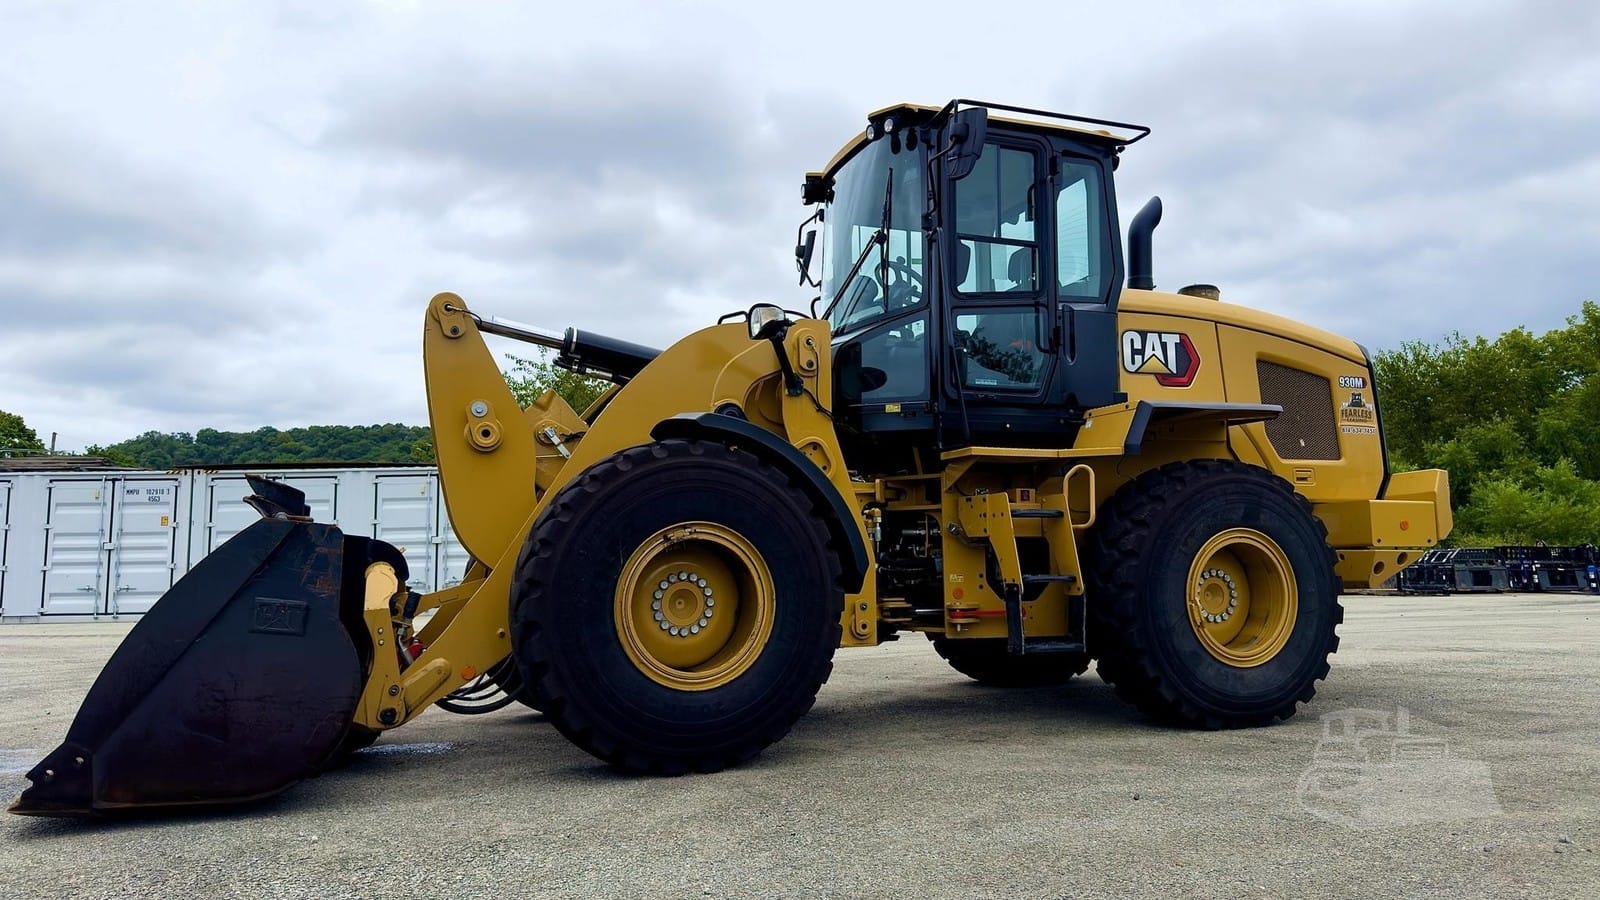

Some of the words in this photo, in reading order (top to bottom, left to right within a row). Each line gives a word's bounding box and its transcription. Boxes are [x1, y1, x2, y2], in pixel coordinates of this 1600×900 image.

[1122, 331, 1180, 374] CAT
[1340, 377, 1363, 388] 930M
[1341, 409, 1372, 419] FEARLESS
